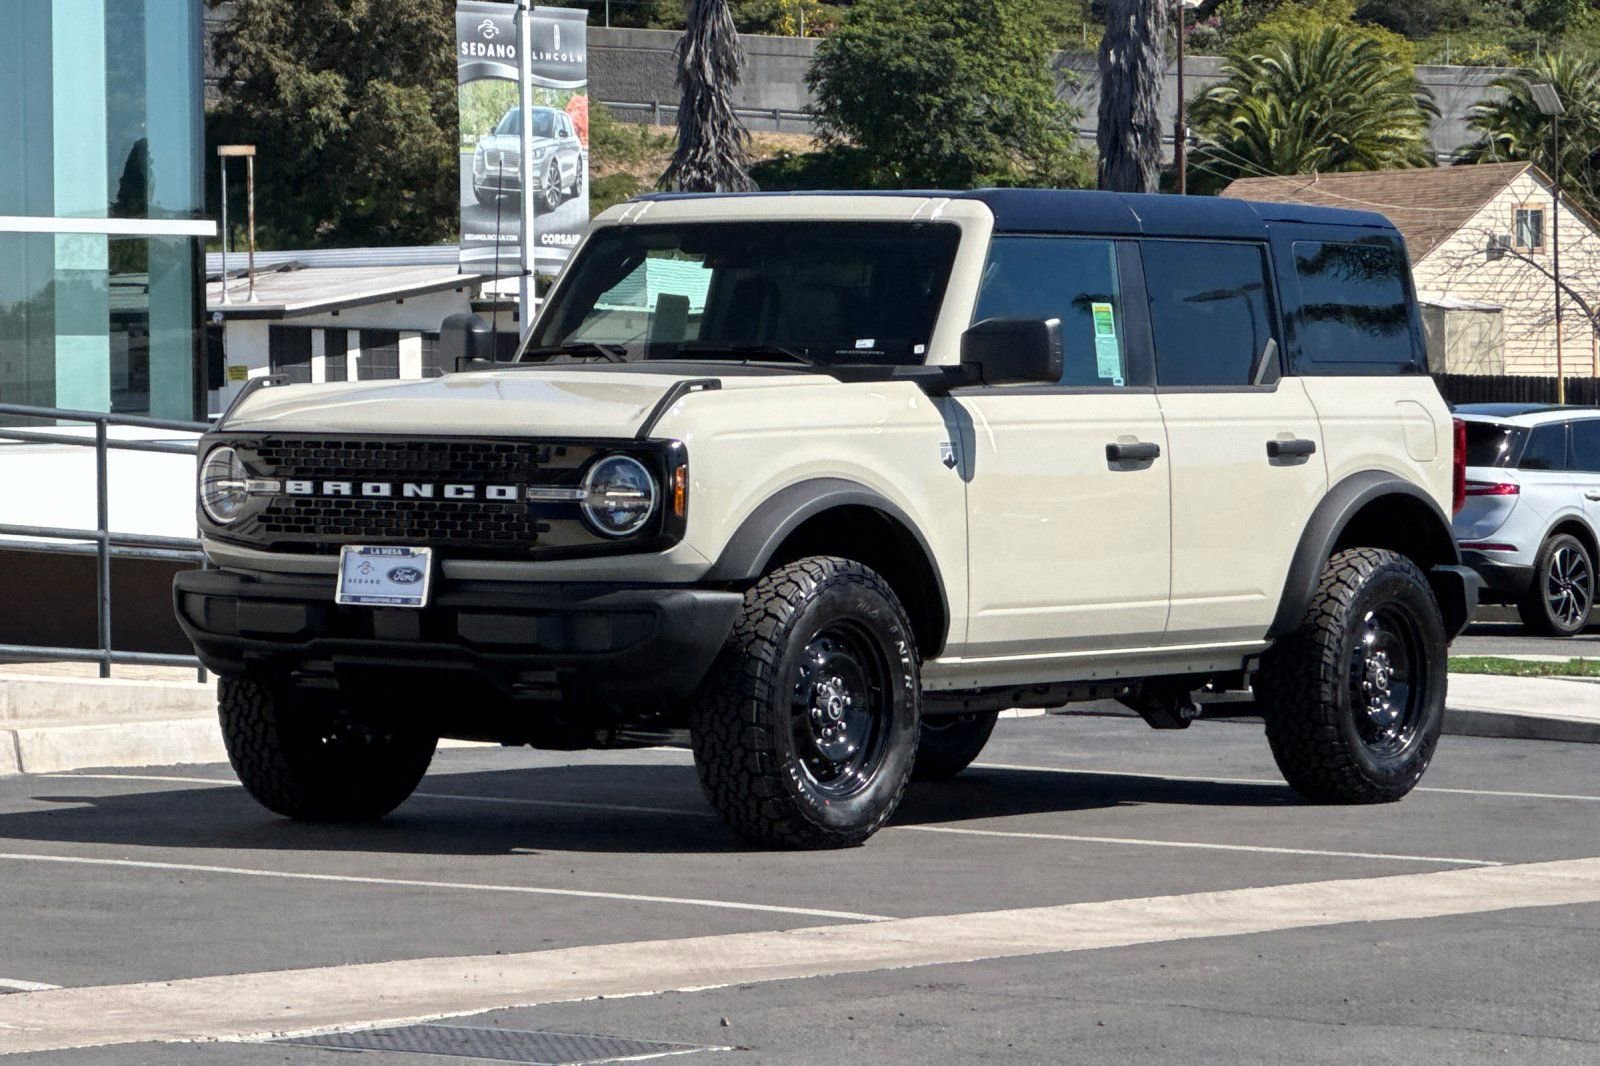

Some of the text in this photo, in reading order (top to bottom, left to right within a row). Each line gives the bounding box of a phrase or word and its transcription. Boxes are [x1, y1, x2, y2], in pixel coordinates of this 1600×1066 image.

[461, 41, 516, 59] SEDANO
[532, 51, 583, 63] LINCOLN
[285, 480, 518, 500] BRONCO
[393, 568, 417, 582] Ford
